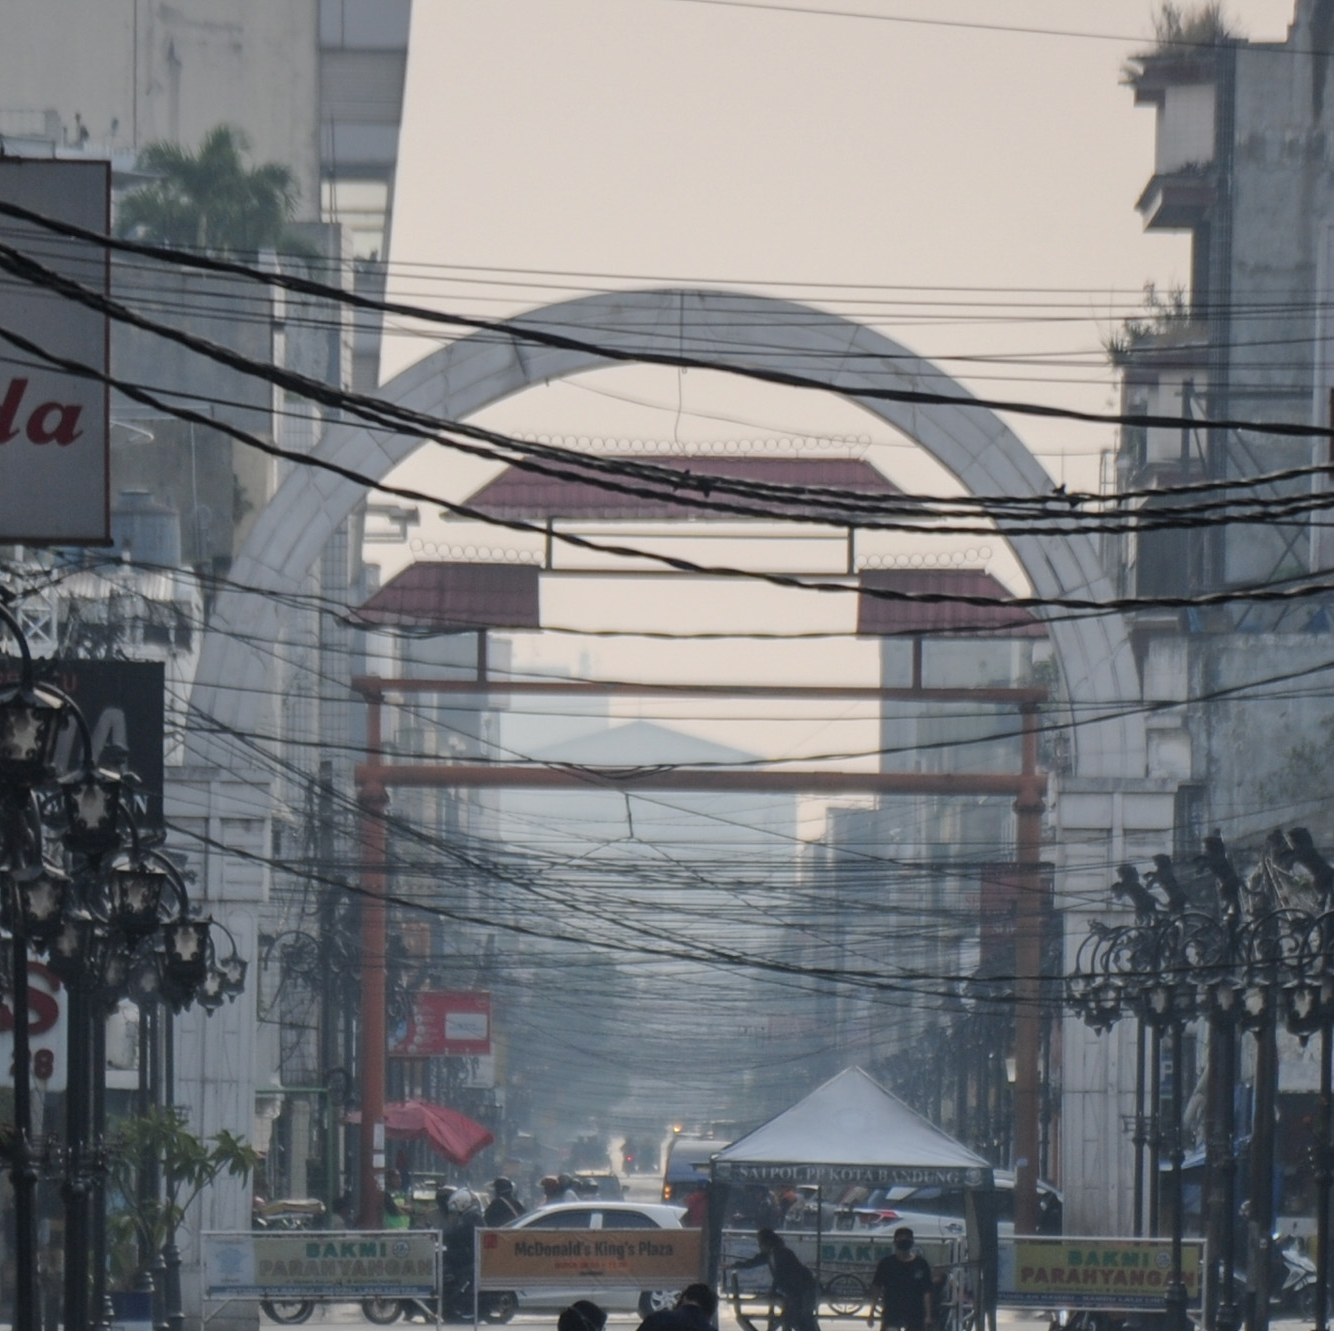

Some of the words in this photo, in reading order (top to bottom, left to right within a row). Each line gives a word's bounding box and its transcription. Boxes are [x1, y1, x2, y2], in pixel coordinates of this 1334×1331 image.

[829, 1168, 874, 1182] KOTA
[878, 1169, 960, 1184] BANDUNG
[306, 1243, 387, 1258] BAKMI
[515, 1241, 591, 1257] McDonald's
[595, 1241, 636, 1259] King's
[639, 1241, 674, 1256] Plaza
[823, 1245, 895, 1261] BAKM
[1068, 1250, 1149, 1267] BAKMI
[259, 1260, 433, 1277] PARAHYANGAN
[1021, 1267, 1195, 1286] PARAHYANGAN
